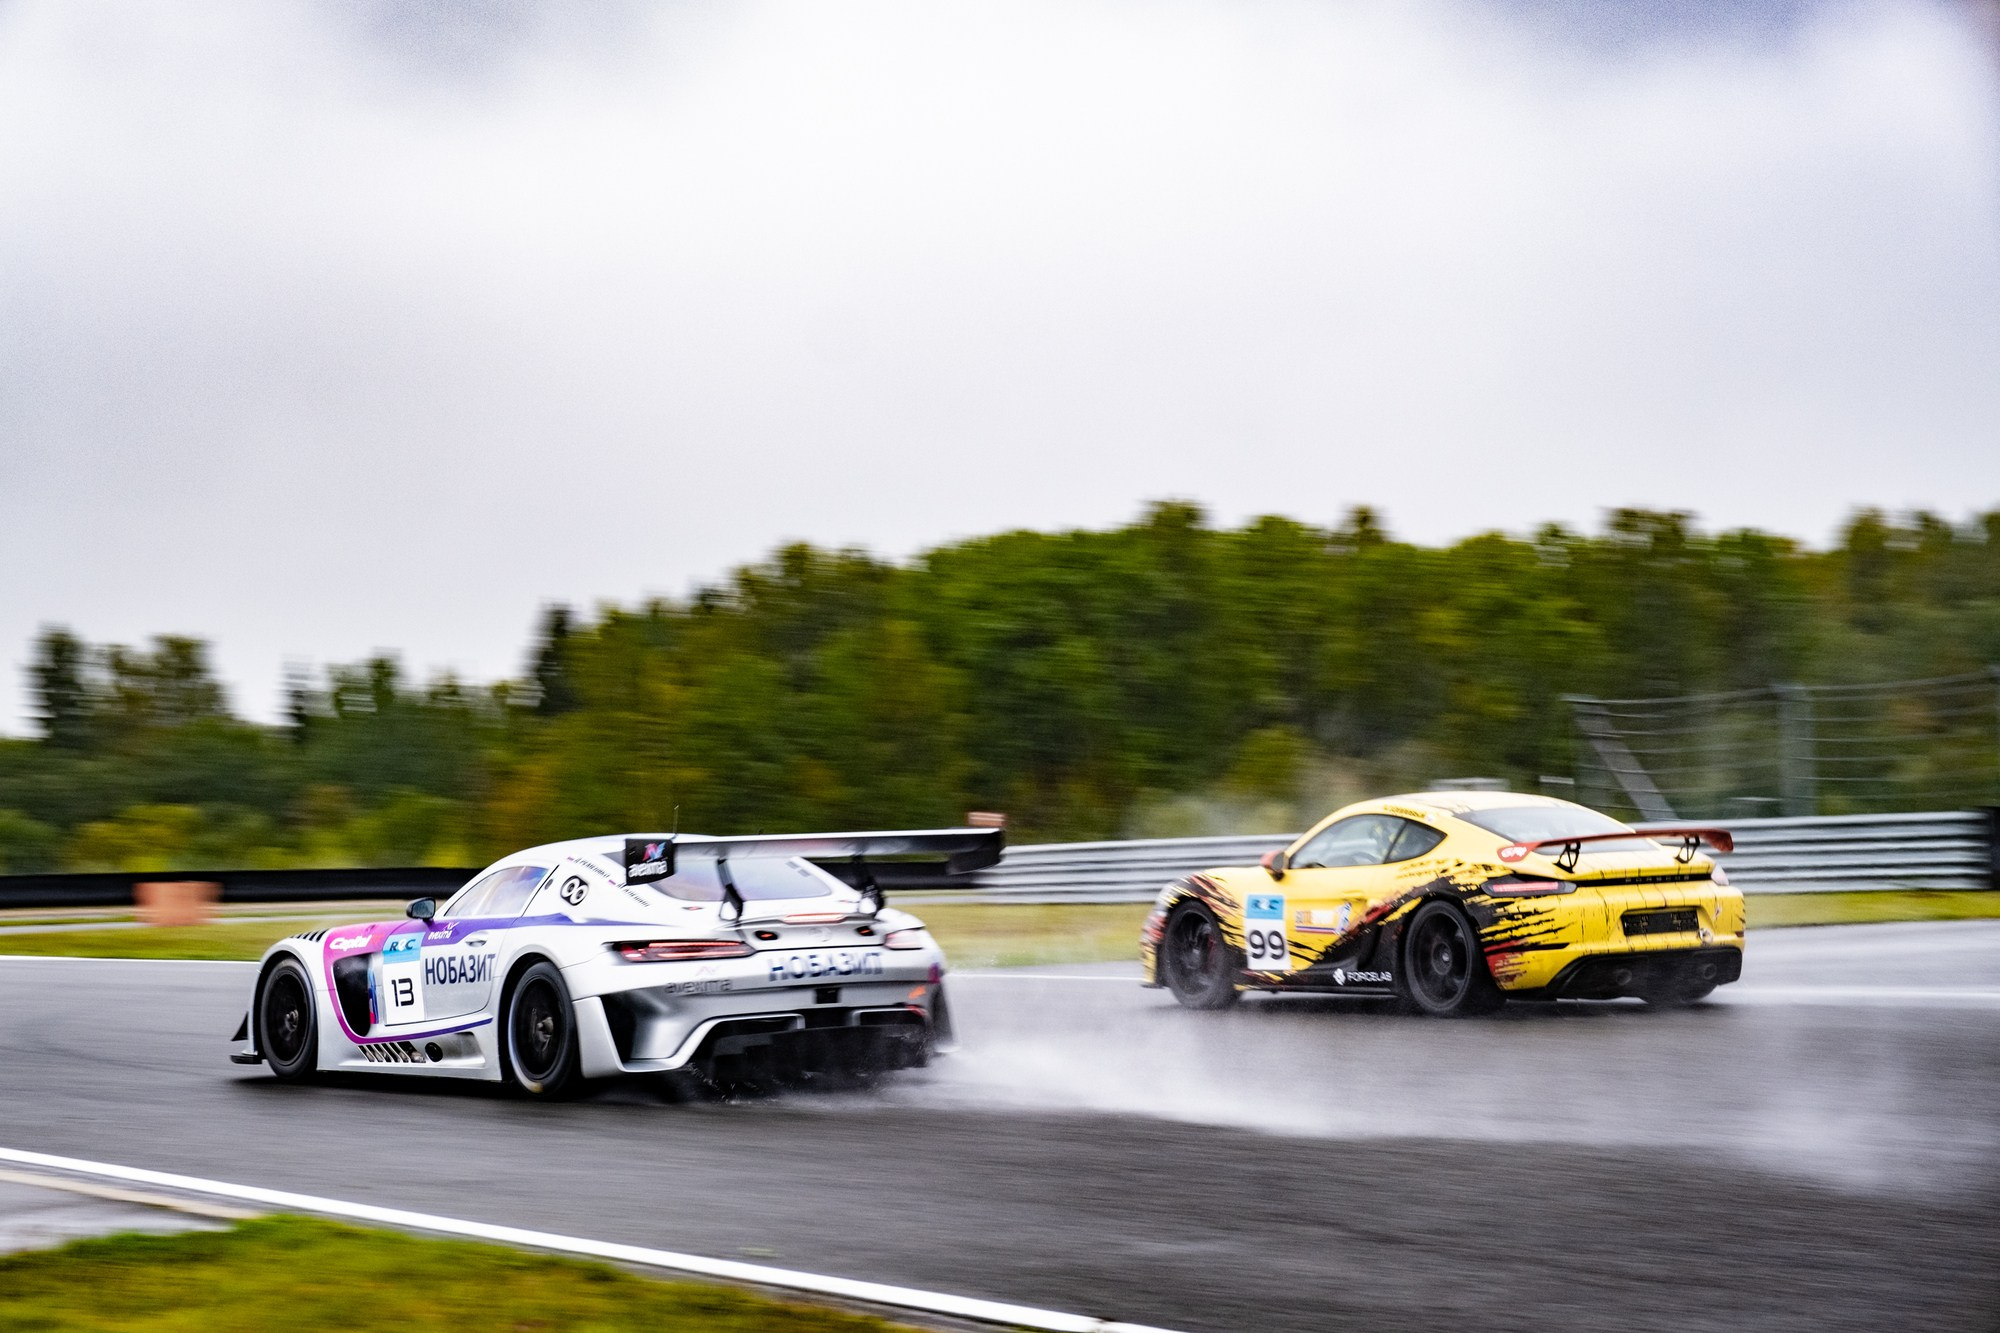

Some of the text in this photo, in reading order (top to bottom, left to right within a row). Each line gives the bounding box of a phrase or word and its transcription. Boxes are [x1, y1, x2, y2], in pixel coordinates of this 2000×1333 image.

[1249, 929, 1285, 960] 99
[425, 953, 496, 986] НОБАЗИТ
[768, 952, 884, 982] НОБАЗИТ
[1346, 971, 1393, 982] FORCELAB
[391, 977, 415, 1008] 13
